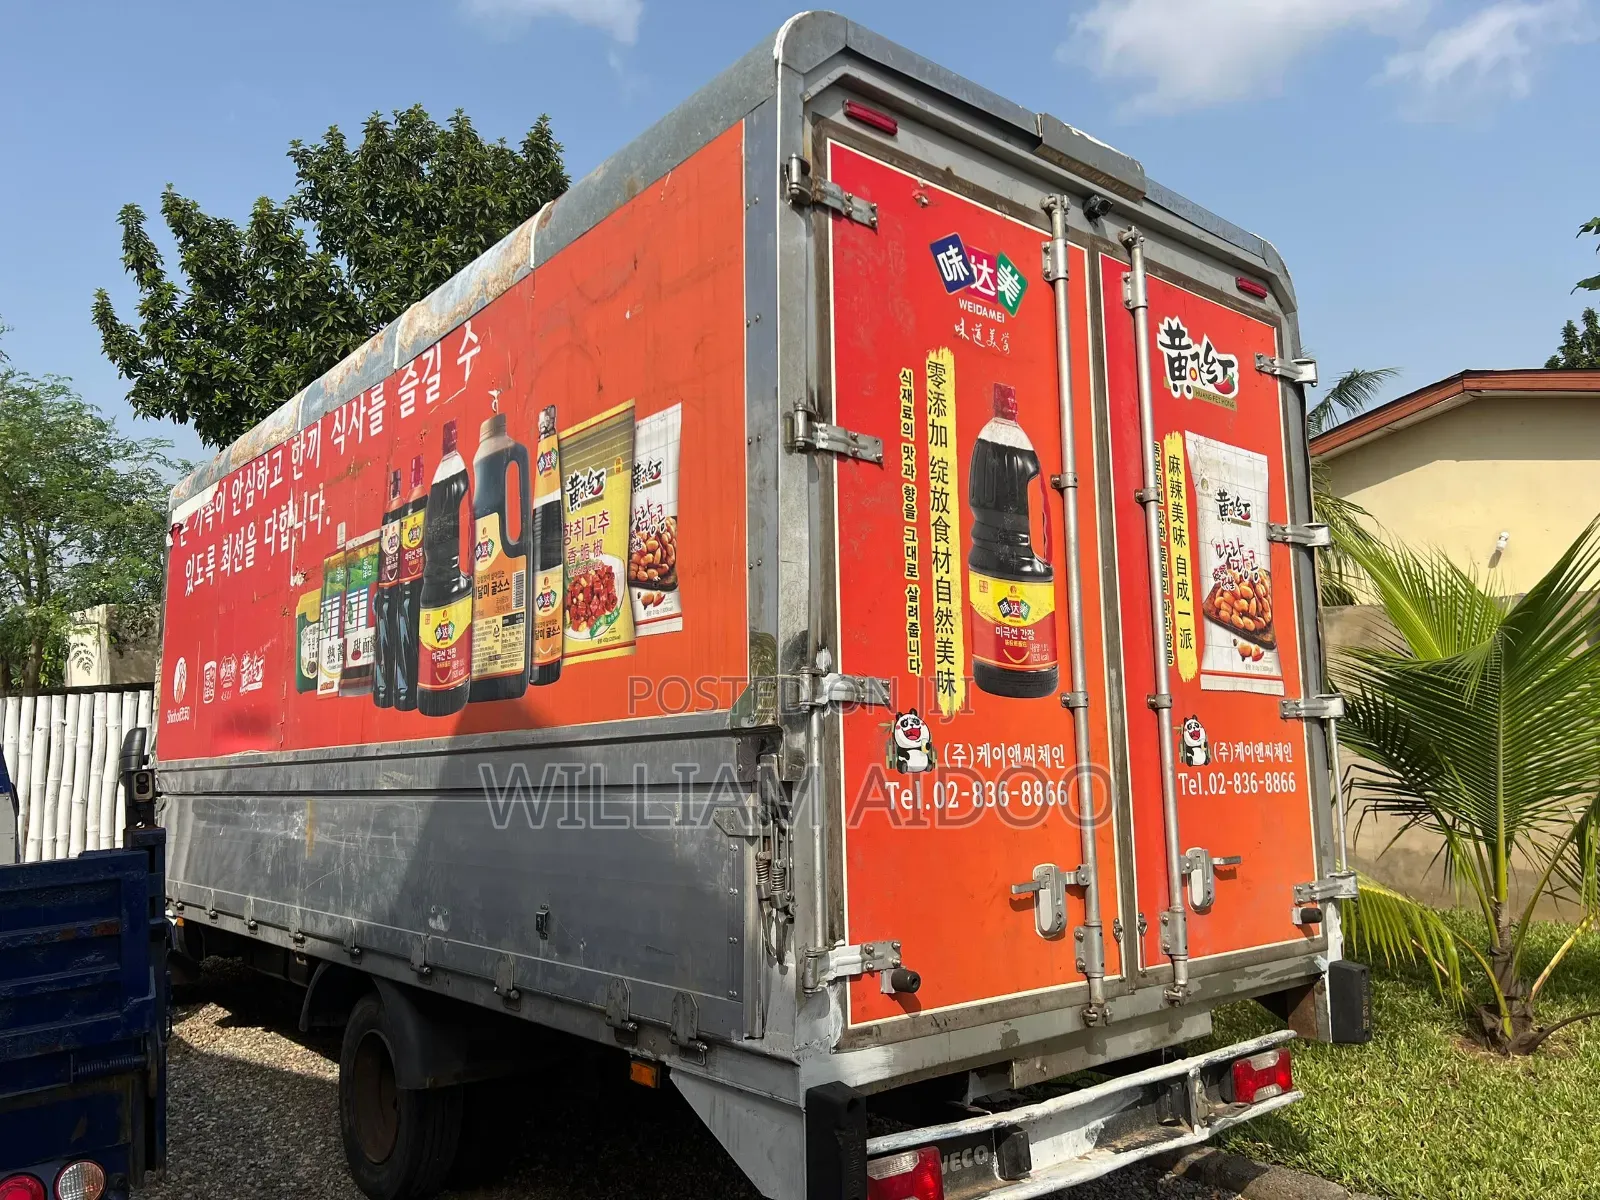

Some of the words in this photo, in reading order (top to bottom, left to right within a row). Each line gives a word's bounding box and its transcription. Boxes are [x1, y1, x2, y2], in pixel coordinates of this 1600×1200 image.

[934, 243, 1023, 309] 味达美
[958, 298, 1005, 323] WEIDAMEI
[231, 449, 283, 517] 안심하고
[290, 418, 322, 475] 한끼
[330, 380, 387, 455] 식사를
[396, 341, 442, 419] 즐길
[455, 319, 482, 382] 수
[900, 370, 914, 439] 식재료의
[927, 360, 949, 449] 零添加
[901, 445, 916, 480] 맛과
[903, 485, 917, 521] 향을
[1168, 454, 1187, 549] 麻辣美味
[184, 544, 216, 598] 있도록
[220, 521, 258, 577] 최선을
[264, 482, 331, 556] 다합니다.
[903, 527, 919, 579] 그대로
[1175, 555, 1194, 650] 自成一派
[906, 586, 921, 675] 살려줍니다
[995, 625, 1018, 640] 미극선
[1019, 628, 1035, 641] 간장
[943, 741, 1066, 771] (주)케이앤씨체인
[1213, 742, 1294, 769] (주)케이앤씨체인
[884, 780, 1069, 812] Tel.02-836-8866
[1177, 771, 1297, 797] Tel.02-836-8866
